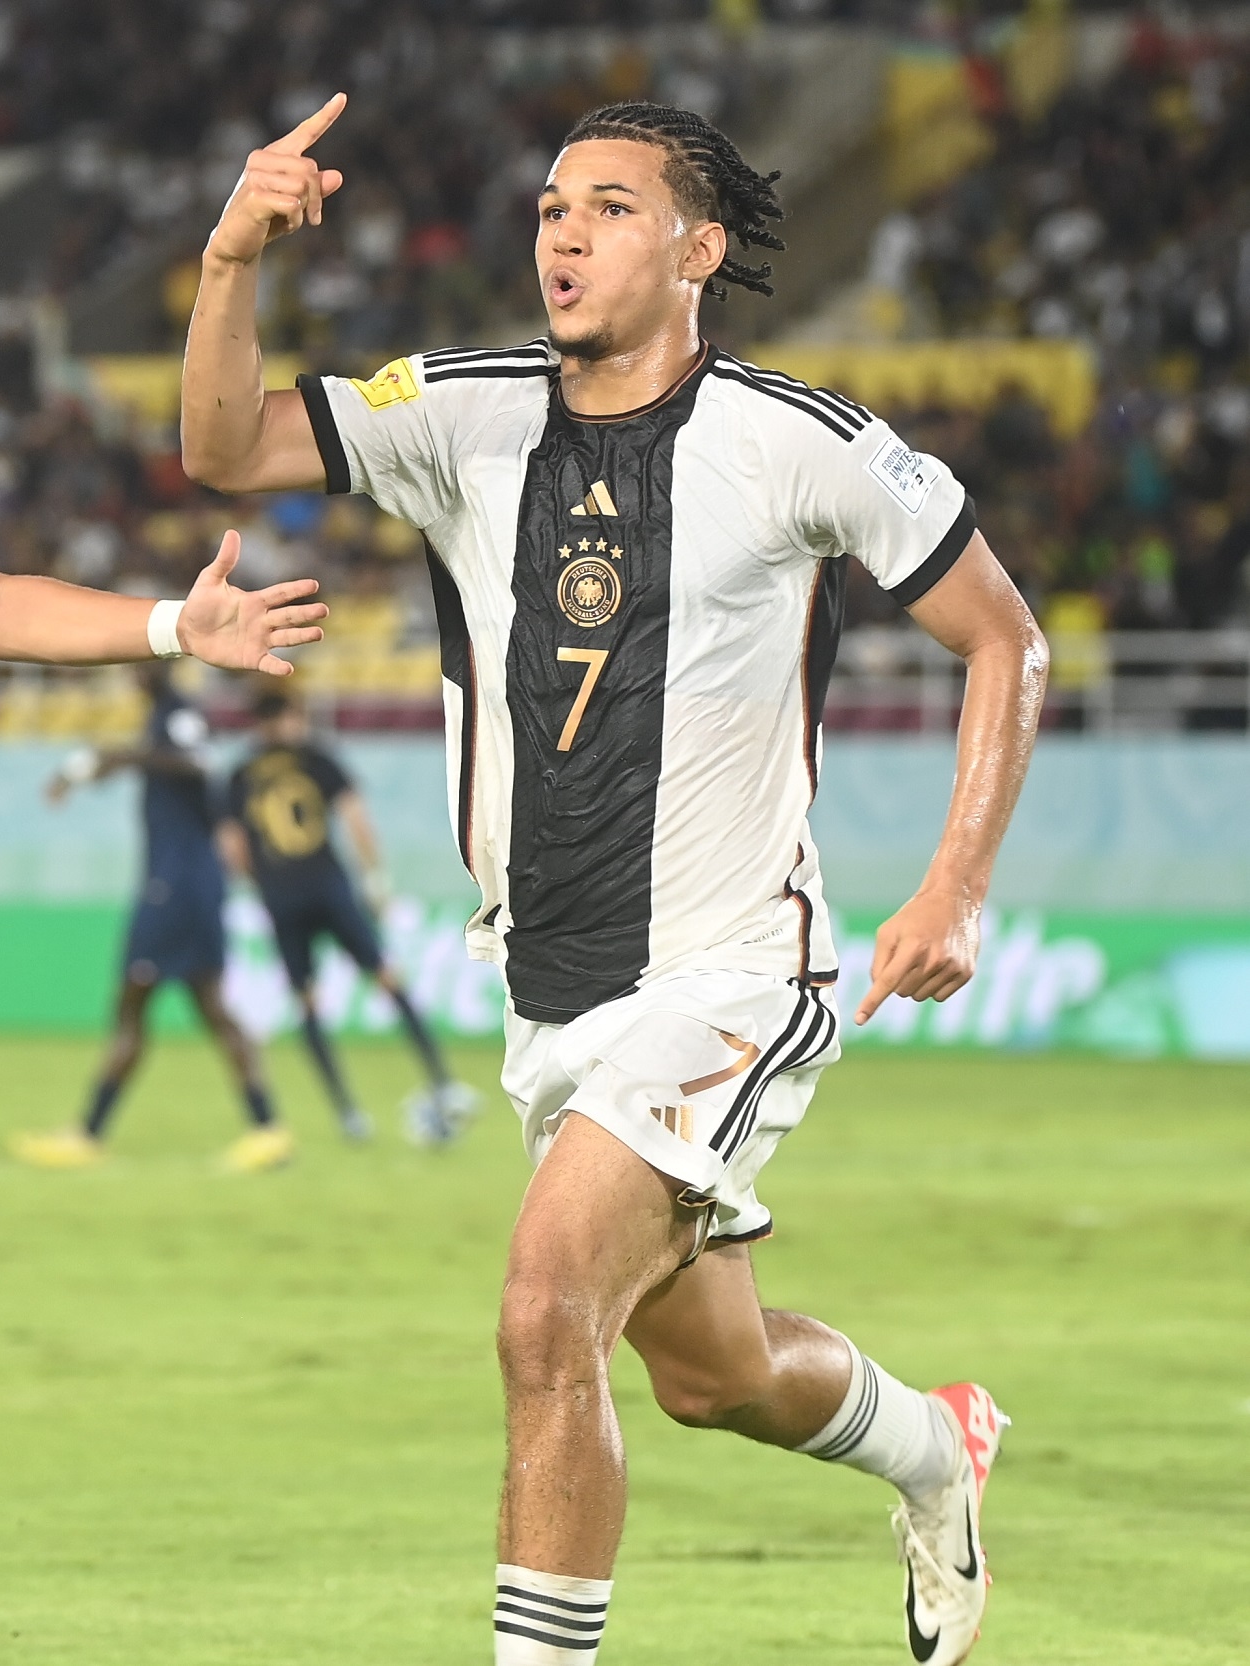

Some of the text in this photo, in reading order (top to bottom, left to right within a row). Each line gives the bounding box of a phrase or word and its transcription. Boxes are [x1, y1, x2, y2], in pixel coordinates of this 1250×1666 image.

[882, 446, 903, 471] FOOTBA
[889, 451, 915, 480] UNITES
[556, 646, 609, 752] 7
